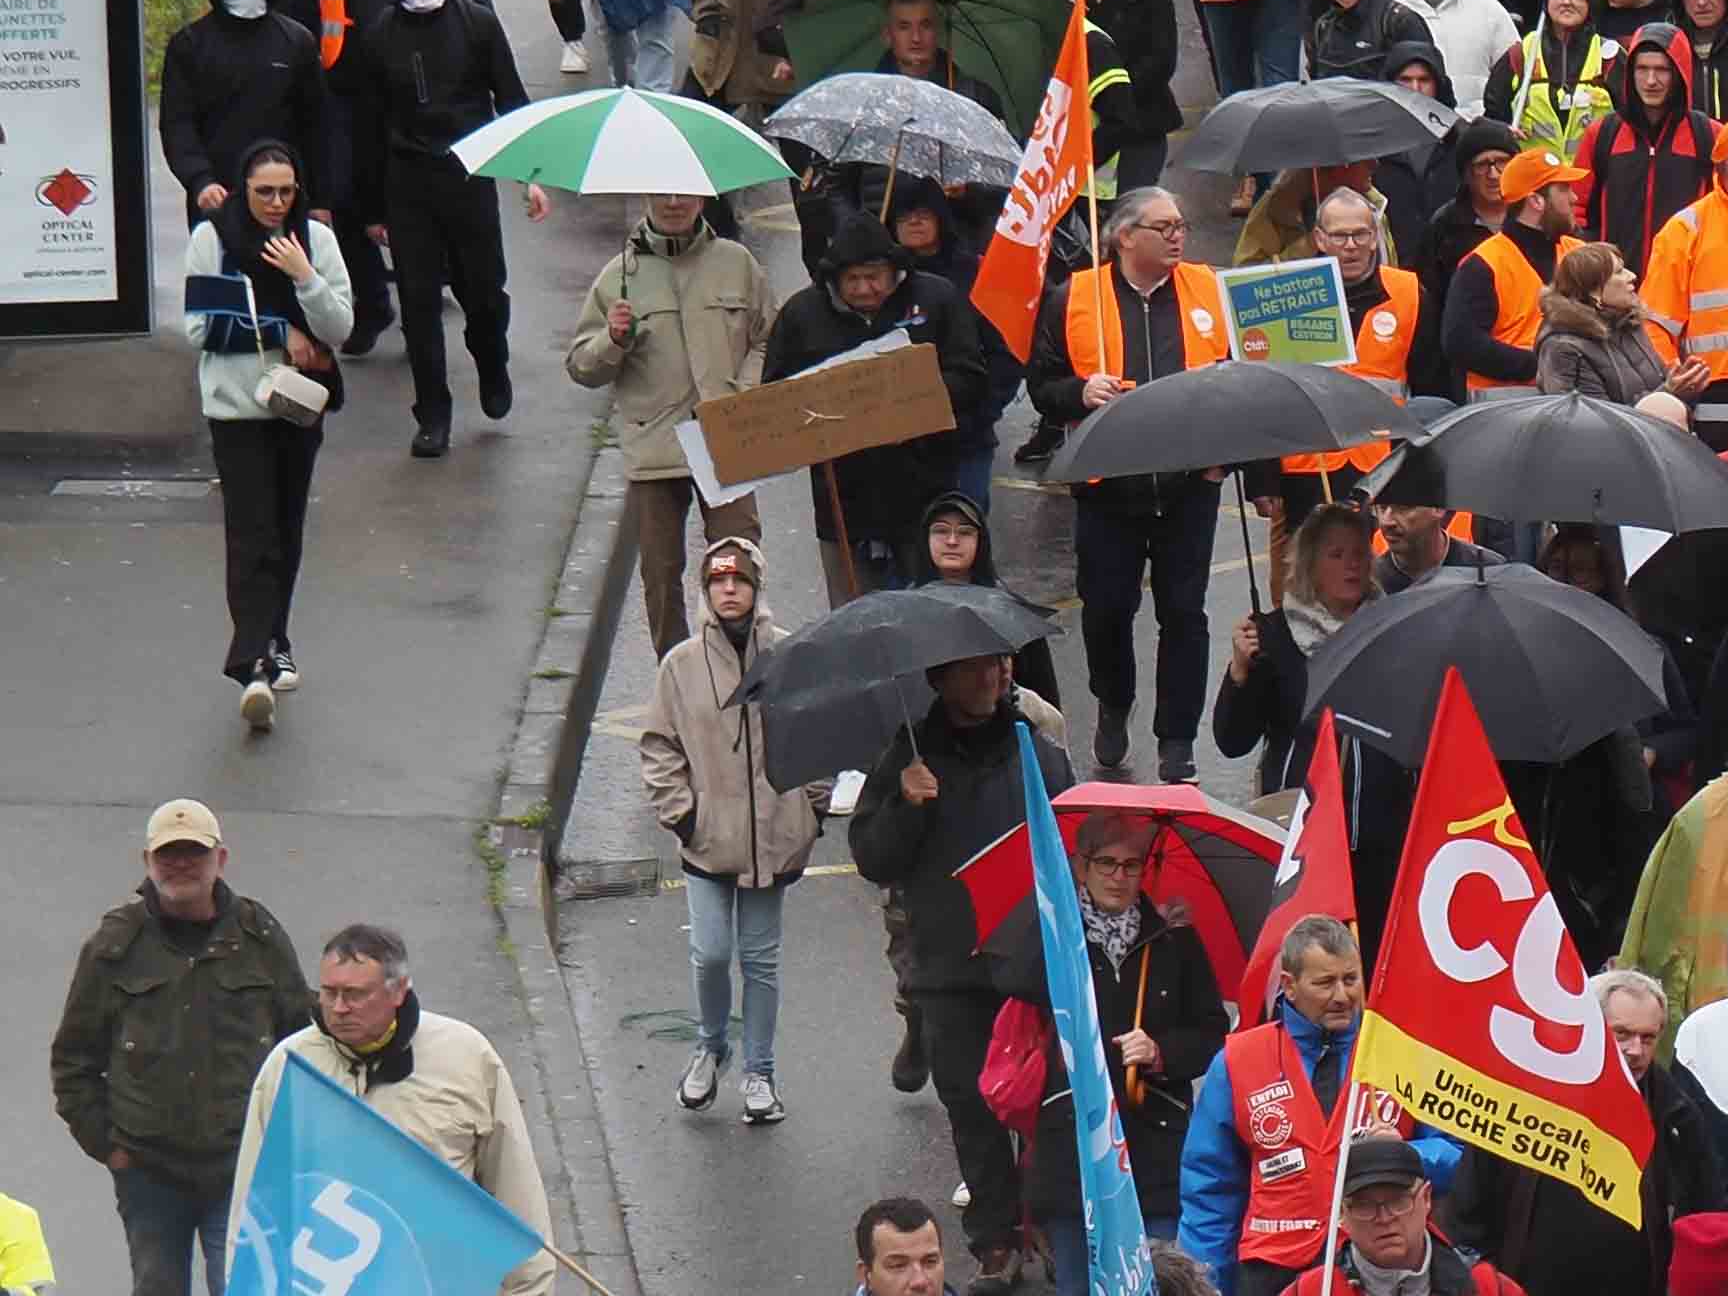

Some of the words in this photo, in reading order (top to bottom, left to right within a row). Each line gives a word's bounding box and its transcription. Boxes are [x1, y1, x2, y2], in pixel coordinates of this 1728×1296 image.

[0, 79, 80, 90] ROGRESSIFS
[41, 220, 94, 231] OPTICAL
[42, 232, 94, 242] CENTER
[1262, 288, 1329, 317] RETRAITE
[1434, 1069, 1499, 1116] Union
[1505, 1098, 1592, 1155] Locale
[1394, 1072, 1415, 1104] LA
[1418, 1090, 1506, 1146] ROCHE
[1510, 1128, 1572, 1172] SUR
[1578, 1157, 1618, 1203] YON
